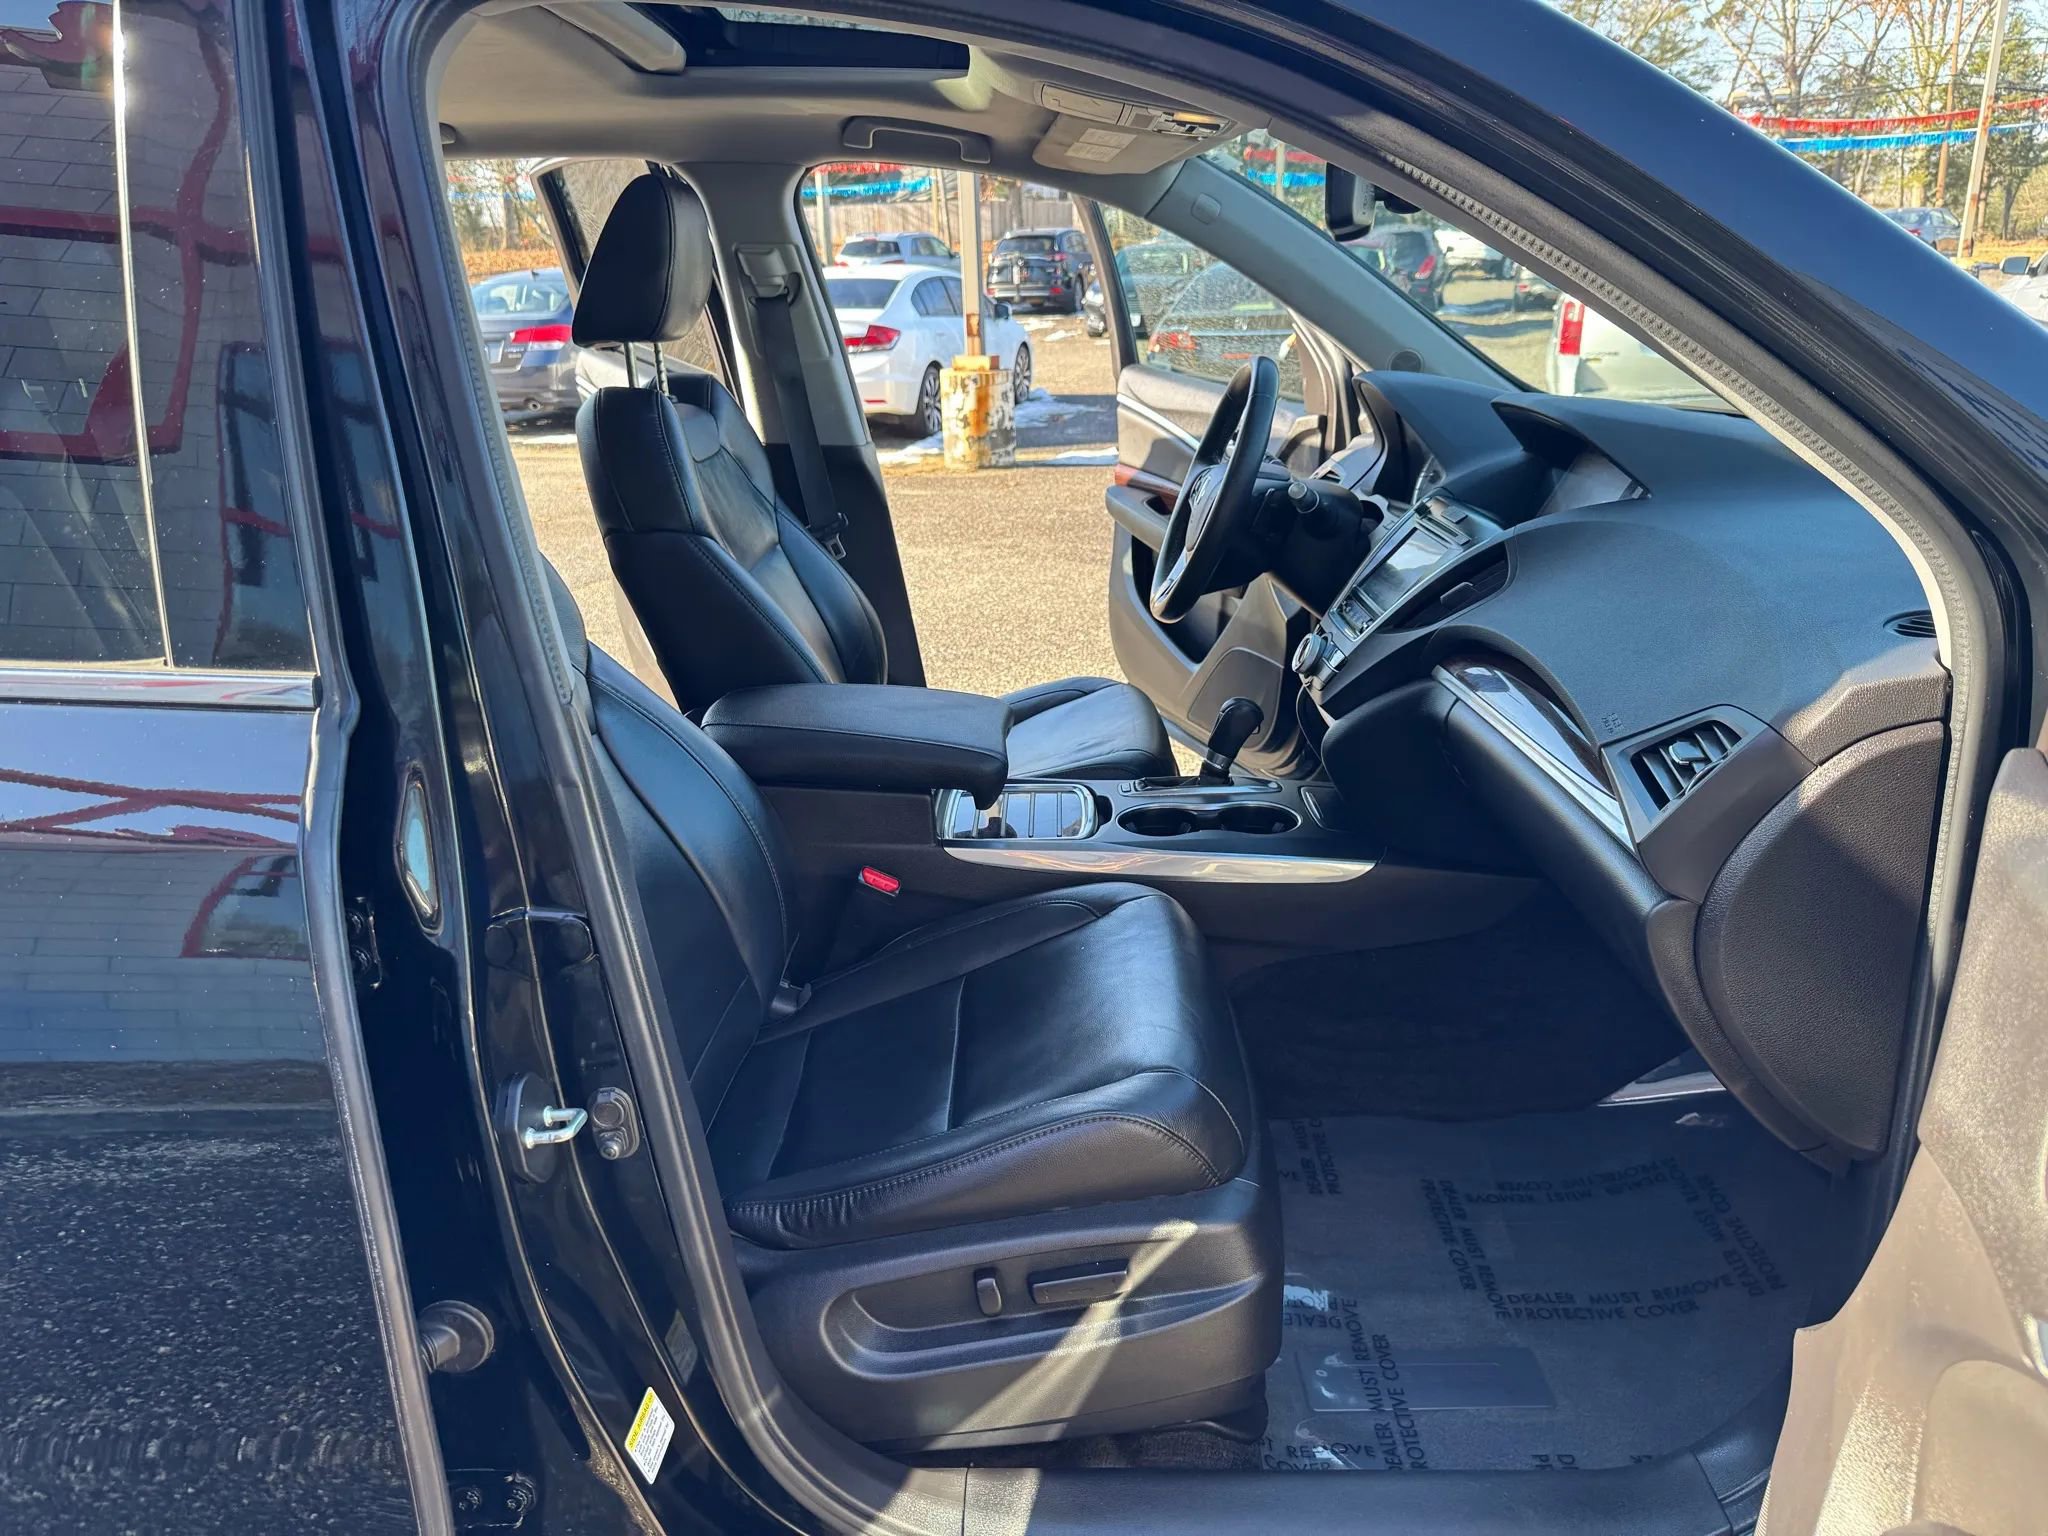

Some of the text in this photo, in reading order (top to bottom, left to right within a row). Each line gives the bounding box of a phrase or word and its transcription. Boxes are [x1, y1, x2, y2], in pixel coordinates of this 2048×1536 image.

[1693, 1209, 1726, 1242] MUST
[1448, 1249, 1478, 1291] COVER
[1459, 1227, 1487, 1260] MUST
[1475, 1264, 1513, 1321] REMOVE
[1506, 1273, 1736, 1305] DEALER MUST REMOVE
[1722, 1250, 1766, 1298] DEALER
[1284, 1313, 1343, 1330] DEALE
[1341, 1297, 1371, 1362] REMOVE
[1516, 1299, 1701, 1321] PROTECTIVE COVER
[1358, 1368, 1386, 1413] MUST
[1372, 1333, 1429, 1470] ROTECTIVE COVER
